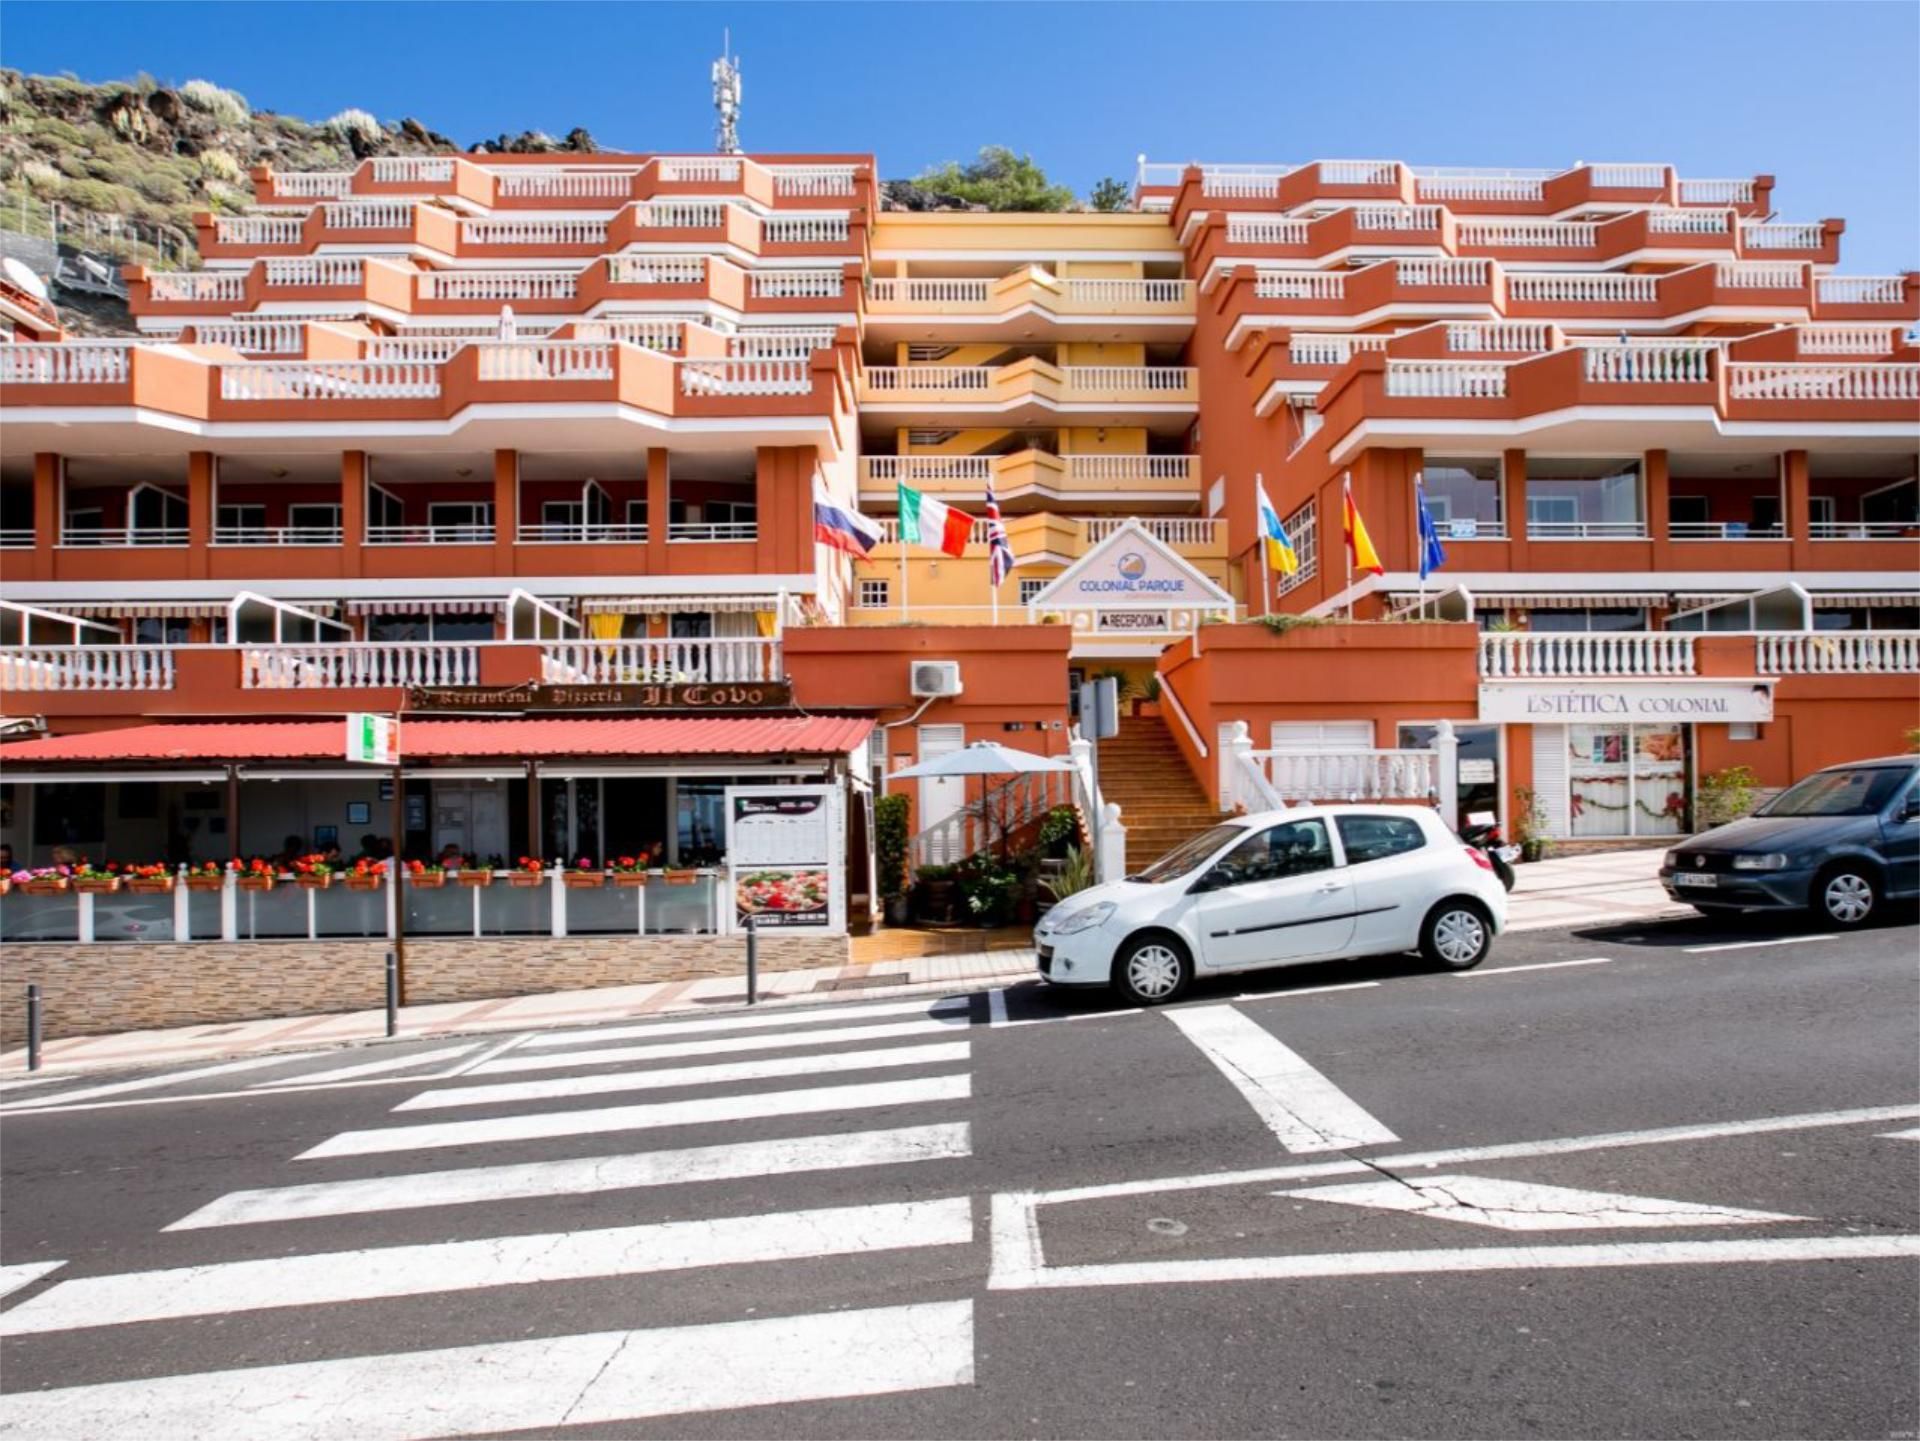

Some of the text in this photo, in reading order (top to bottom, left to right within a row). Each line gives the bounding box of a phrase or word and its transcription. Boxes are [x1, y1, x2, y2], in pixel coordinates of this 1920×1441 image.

[1079, 579, 1185, 591] COLONIAL PARQUE
[681, 686, 763, 705] Covo
[1527, 690, 1729, 713] ESTÉTICA COLONIAL
